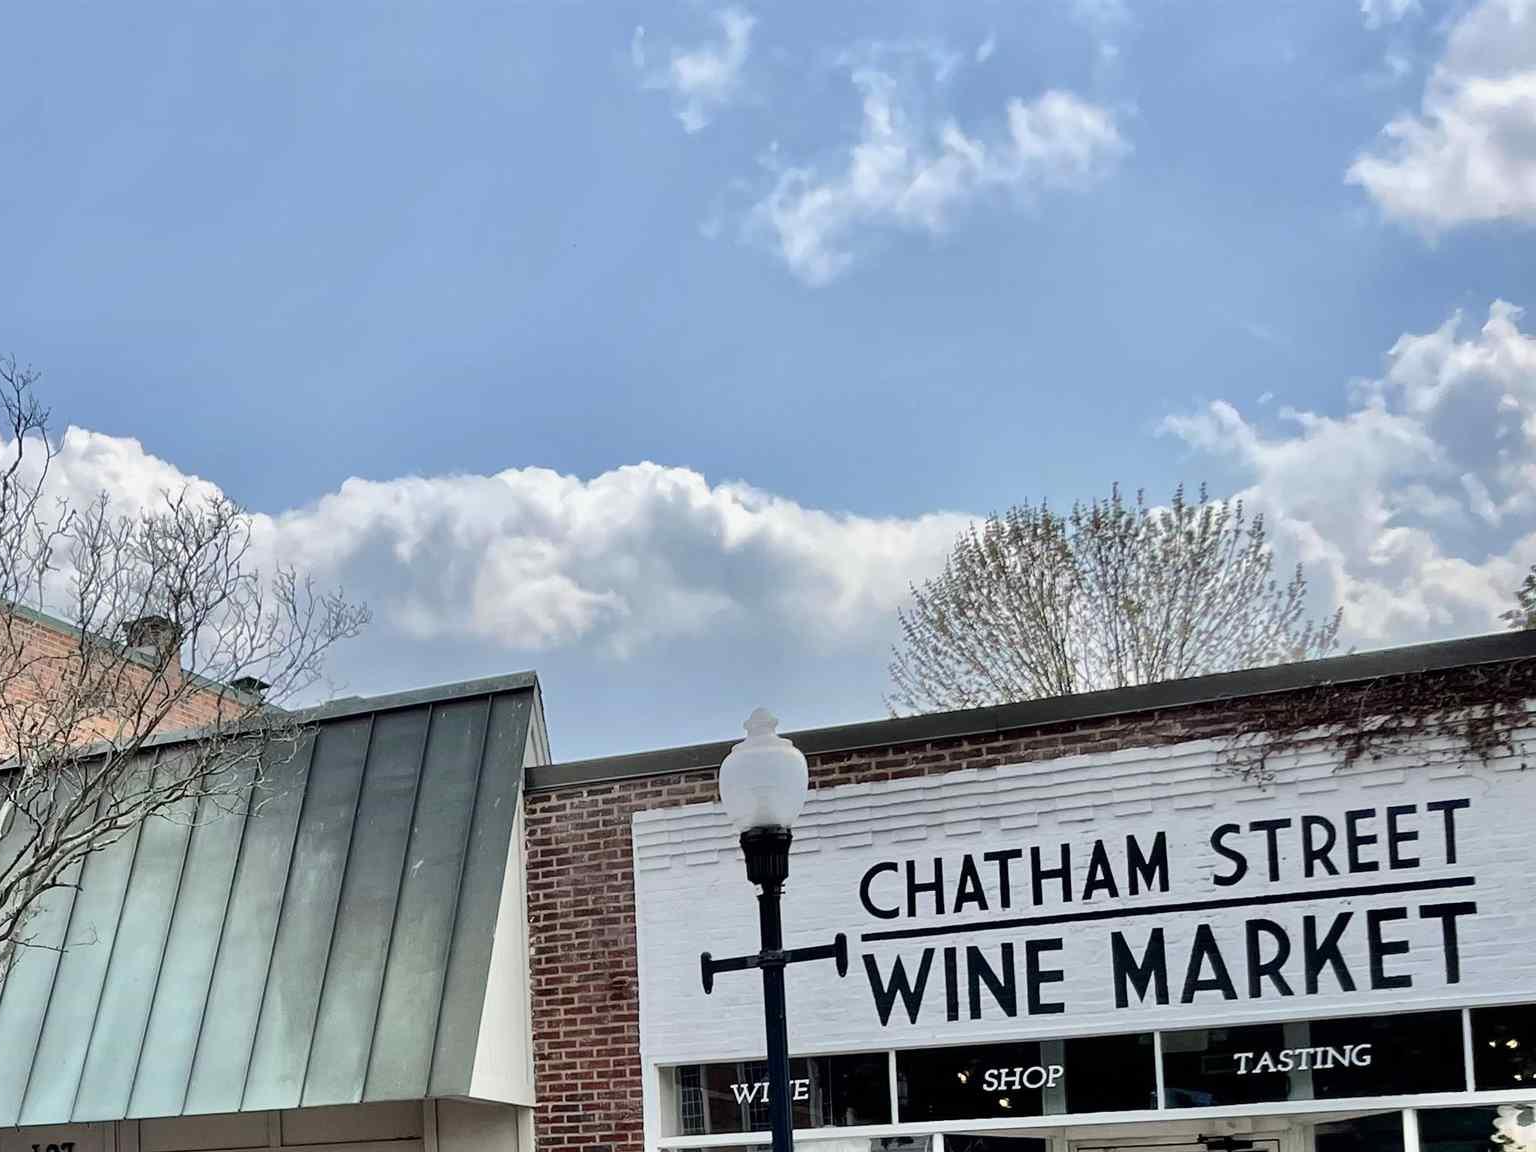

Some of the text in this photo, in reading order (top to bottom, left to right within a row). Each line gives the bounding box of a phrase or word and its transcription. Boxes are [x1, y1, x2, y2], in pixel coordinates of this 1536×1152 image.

[860, 798, 1471, 919] CHATHAM STREET
[862, 901, 1477, 1028] WINE MARKET
[1233, 1043, 1372, 1075] TASTING
[730, 1079, 810, 1104] WIE
[982, 1065, 1064, 1092] SHOP
